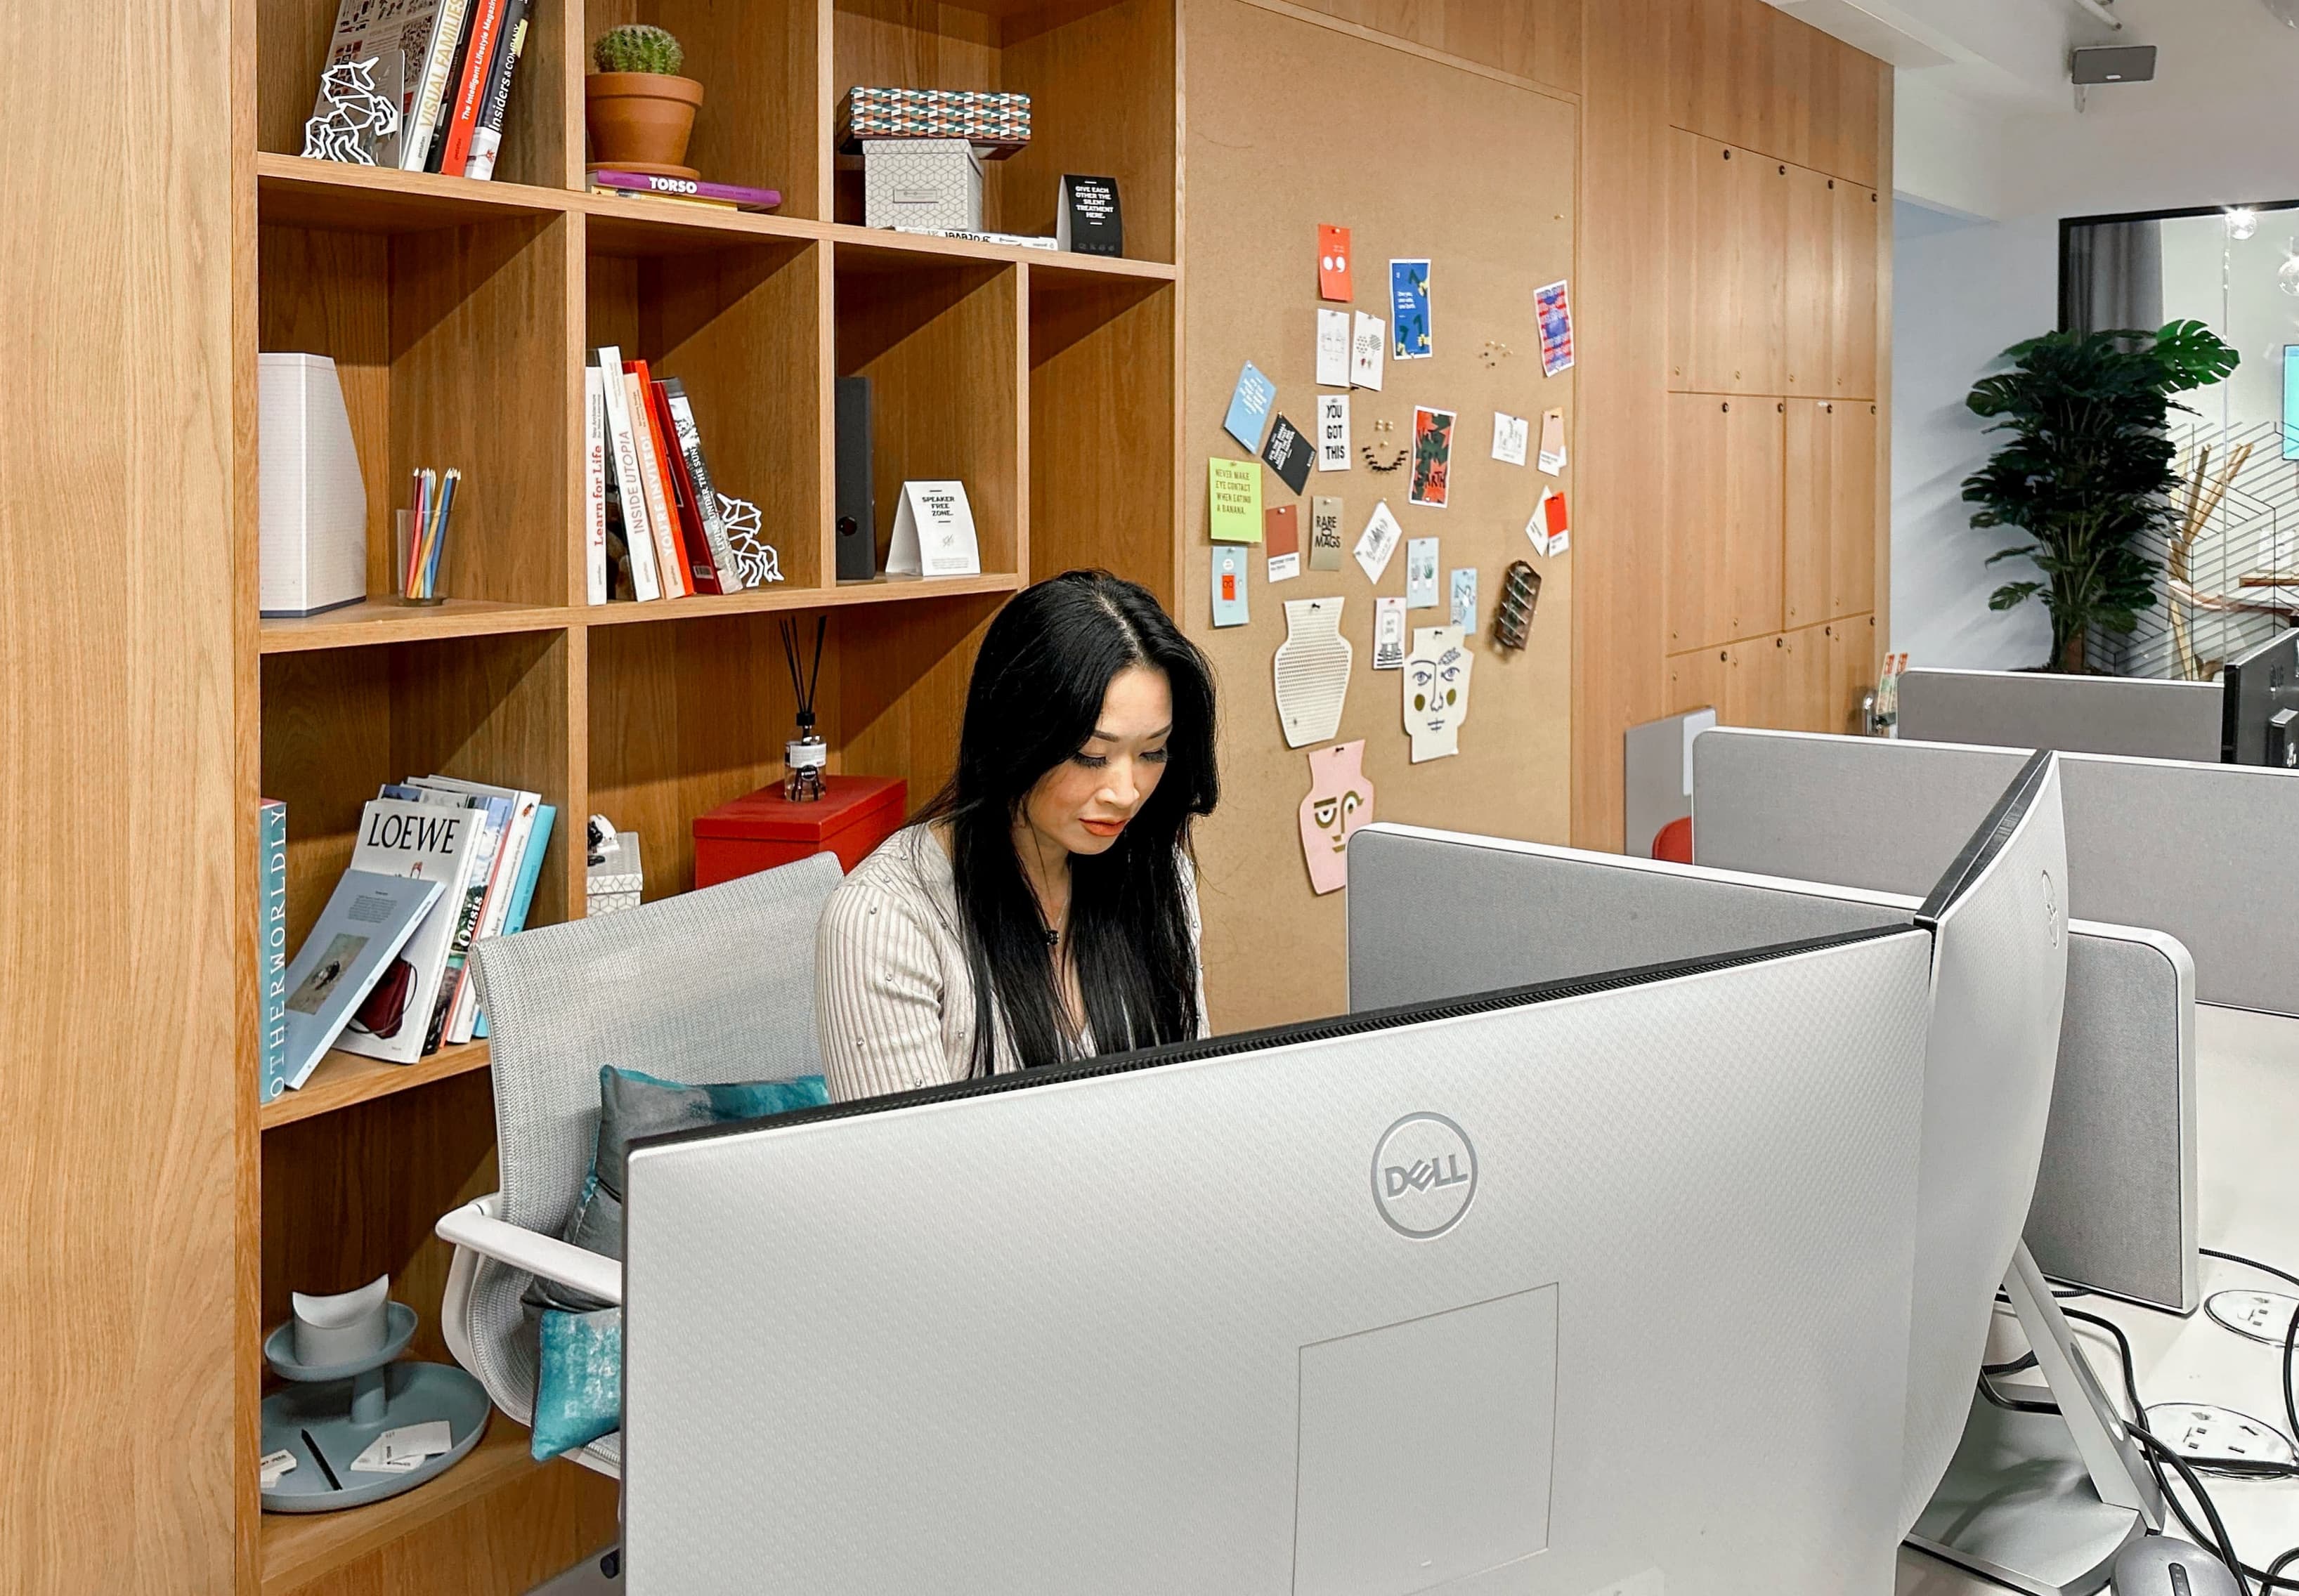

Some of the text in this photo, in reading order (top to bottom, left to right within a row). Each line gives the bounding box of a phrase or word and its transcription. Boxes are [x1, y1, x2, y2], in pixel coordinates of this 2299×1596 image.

[420, 0, 464, 127] VISUAL FAMILIES
[475, 31, 490, 65] Lifestyle
[465, 65, 481, 105] Intelligent
[461, 107, 471, 120] The
[488, 77, 512, 132] Insiders
[649, 176, 698, 194] TORSO
[1327, 405, 1342, 418] YOU
[1327, 425, 1343, 439] GOT
[1326, 445, 1345, 459] THIS
[619, 431, 645, 534] INSIDE UTOPIA
[1216, 469, 1249, 480] NEVER MAKE
[1216, 480, 1250, 492] EYE CONTACT
[592, 445, 604, 547] Learn for Life
[640, 434, 673, 557] YOU'RE INVITED!
[691, 447, 725, 551] LIVING UNDER THE SUN
[1216, 492, 1251, 504] WHEN EATING
[1222, 504, 1246, 514] BANANA.
[1316, 516, 1336, 528] RARE
[1315, 536, 1341, 549] MAGS
[367, 813, 460, 853] LOEWE
[457, 896, 483, 947] Oasis
[270, 806, 286, 1097] OTHERWORLDLY
[1385, 1154, 1468, 1197] DELL
